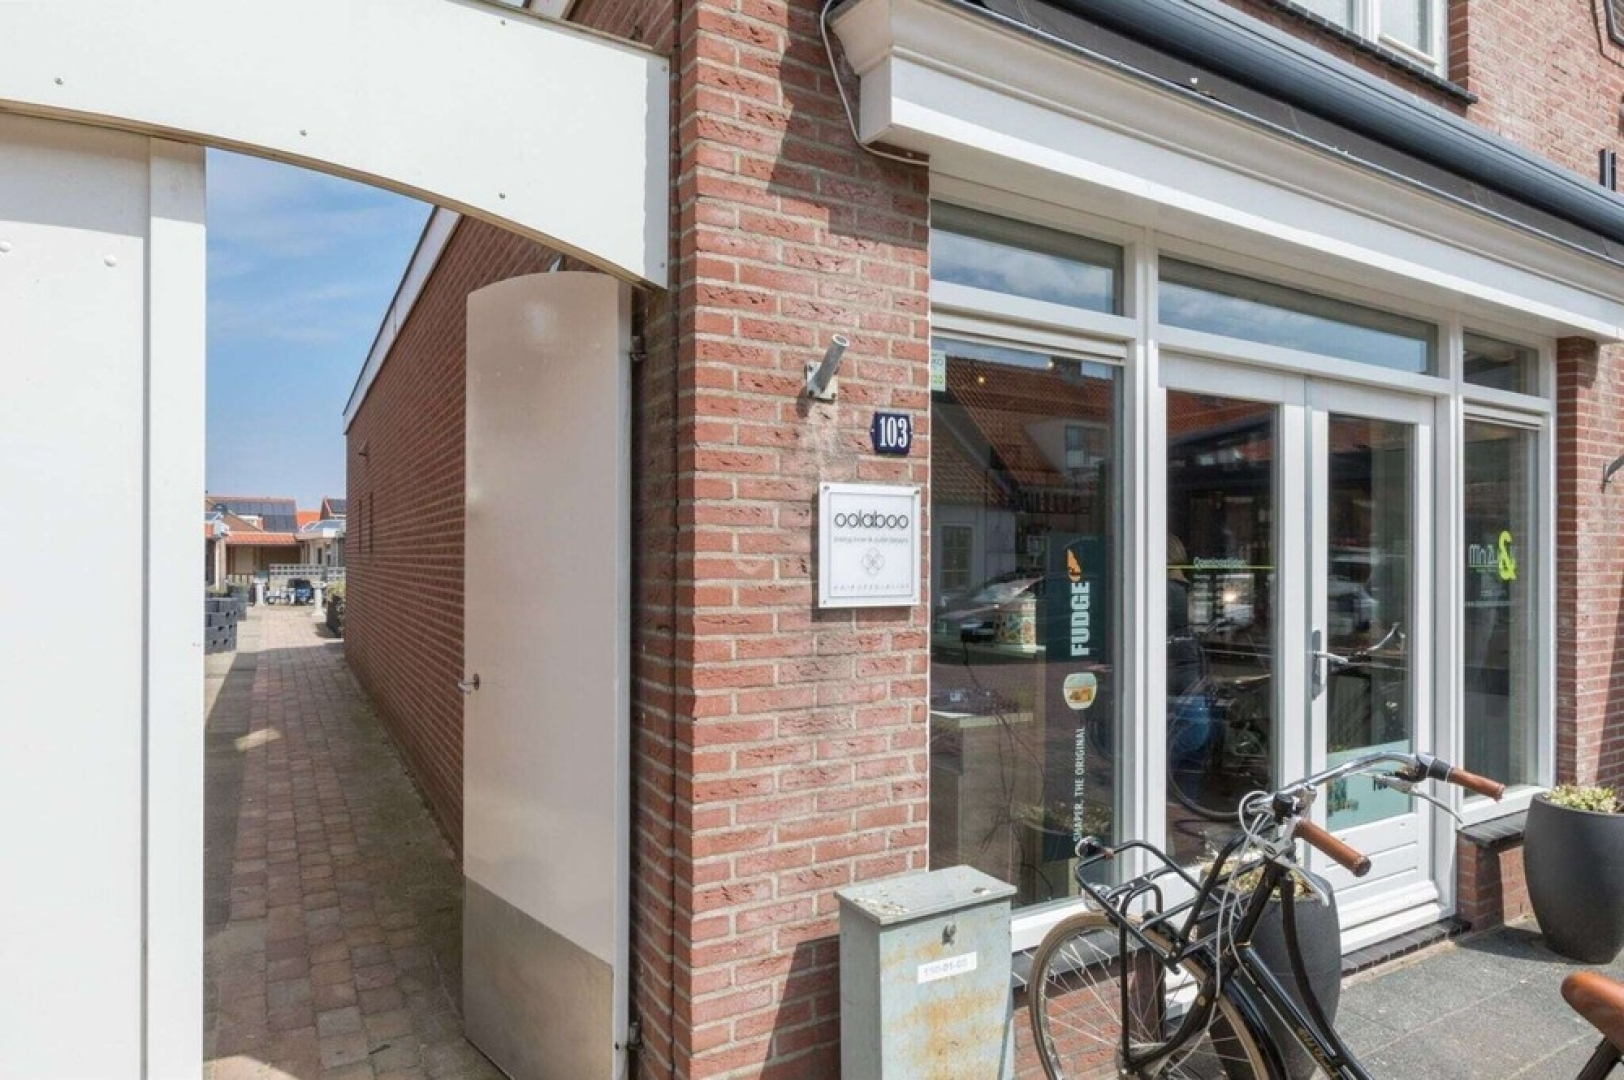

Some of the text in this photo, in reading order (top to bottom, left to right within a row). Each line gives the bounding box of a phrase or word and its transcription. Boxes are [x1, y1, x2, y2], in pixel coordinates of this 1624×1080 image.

[880, 416, 909, 448] 103
[834, 509, 909, 529] oolaboo
[1070, 581, 1091, 656] FUDGE
[1075, 726, 1086, 776] ORIGINAL
[1075, 779, 1084, 797] THE
